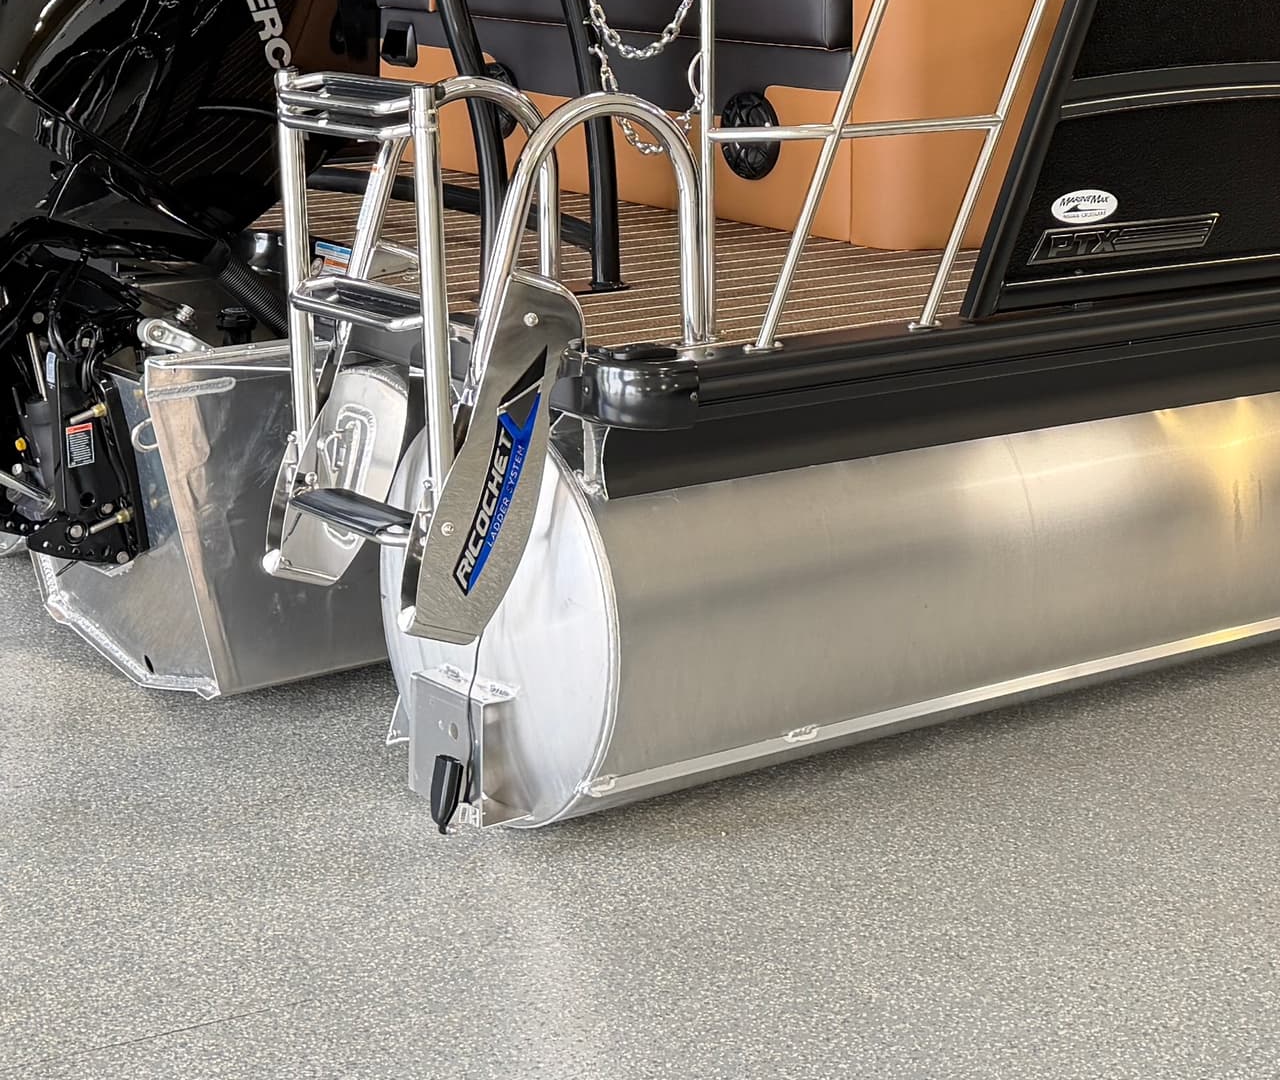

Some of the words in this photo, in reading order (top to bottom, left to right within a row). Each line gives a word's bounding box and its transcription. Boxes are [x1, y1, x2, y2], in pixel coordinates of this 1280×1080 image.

[1047, 229, 1120, 258] PTX
[456, 427, 512, 589] RICOCHET
[486, 499, 510, 548] LADDER
[507, 445, 524, 495] SYSTEM
